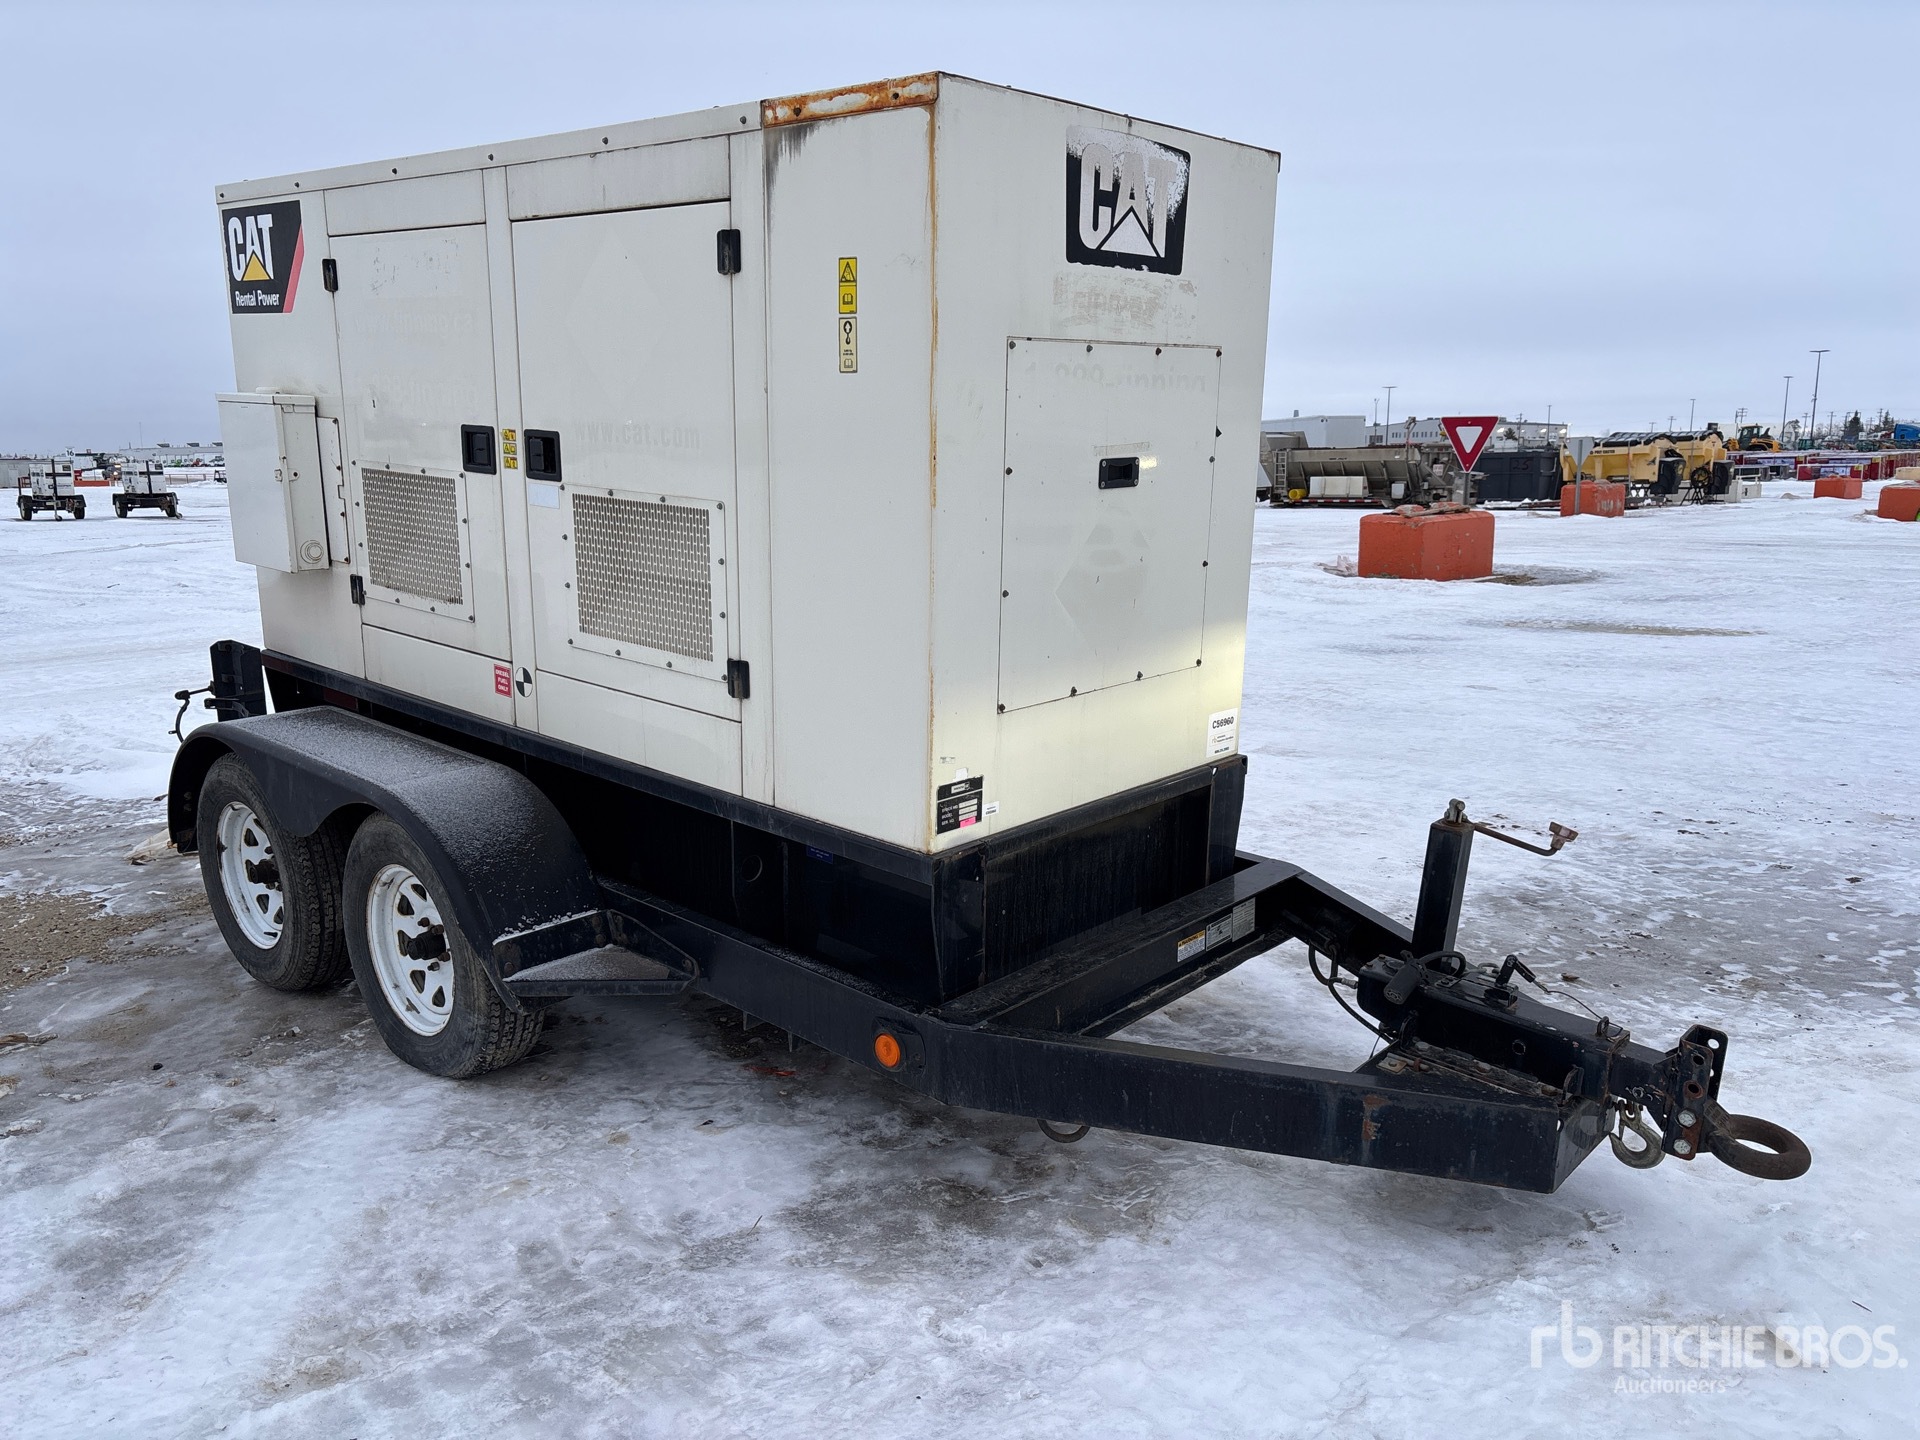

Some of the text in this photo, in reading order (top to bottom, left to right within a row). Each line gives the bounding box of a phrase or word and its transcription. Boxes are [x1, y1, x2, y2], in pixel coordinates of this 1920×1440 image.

[1078, 142, 1178, 258] CAT
[228, 213, 274, 282] CAT
[235, 289, 280, 307] Rental Power
